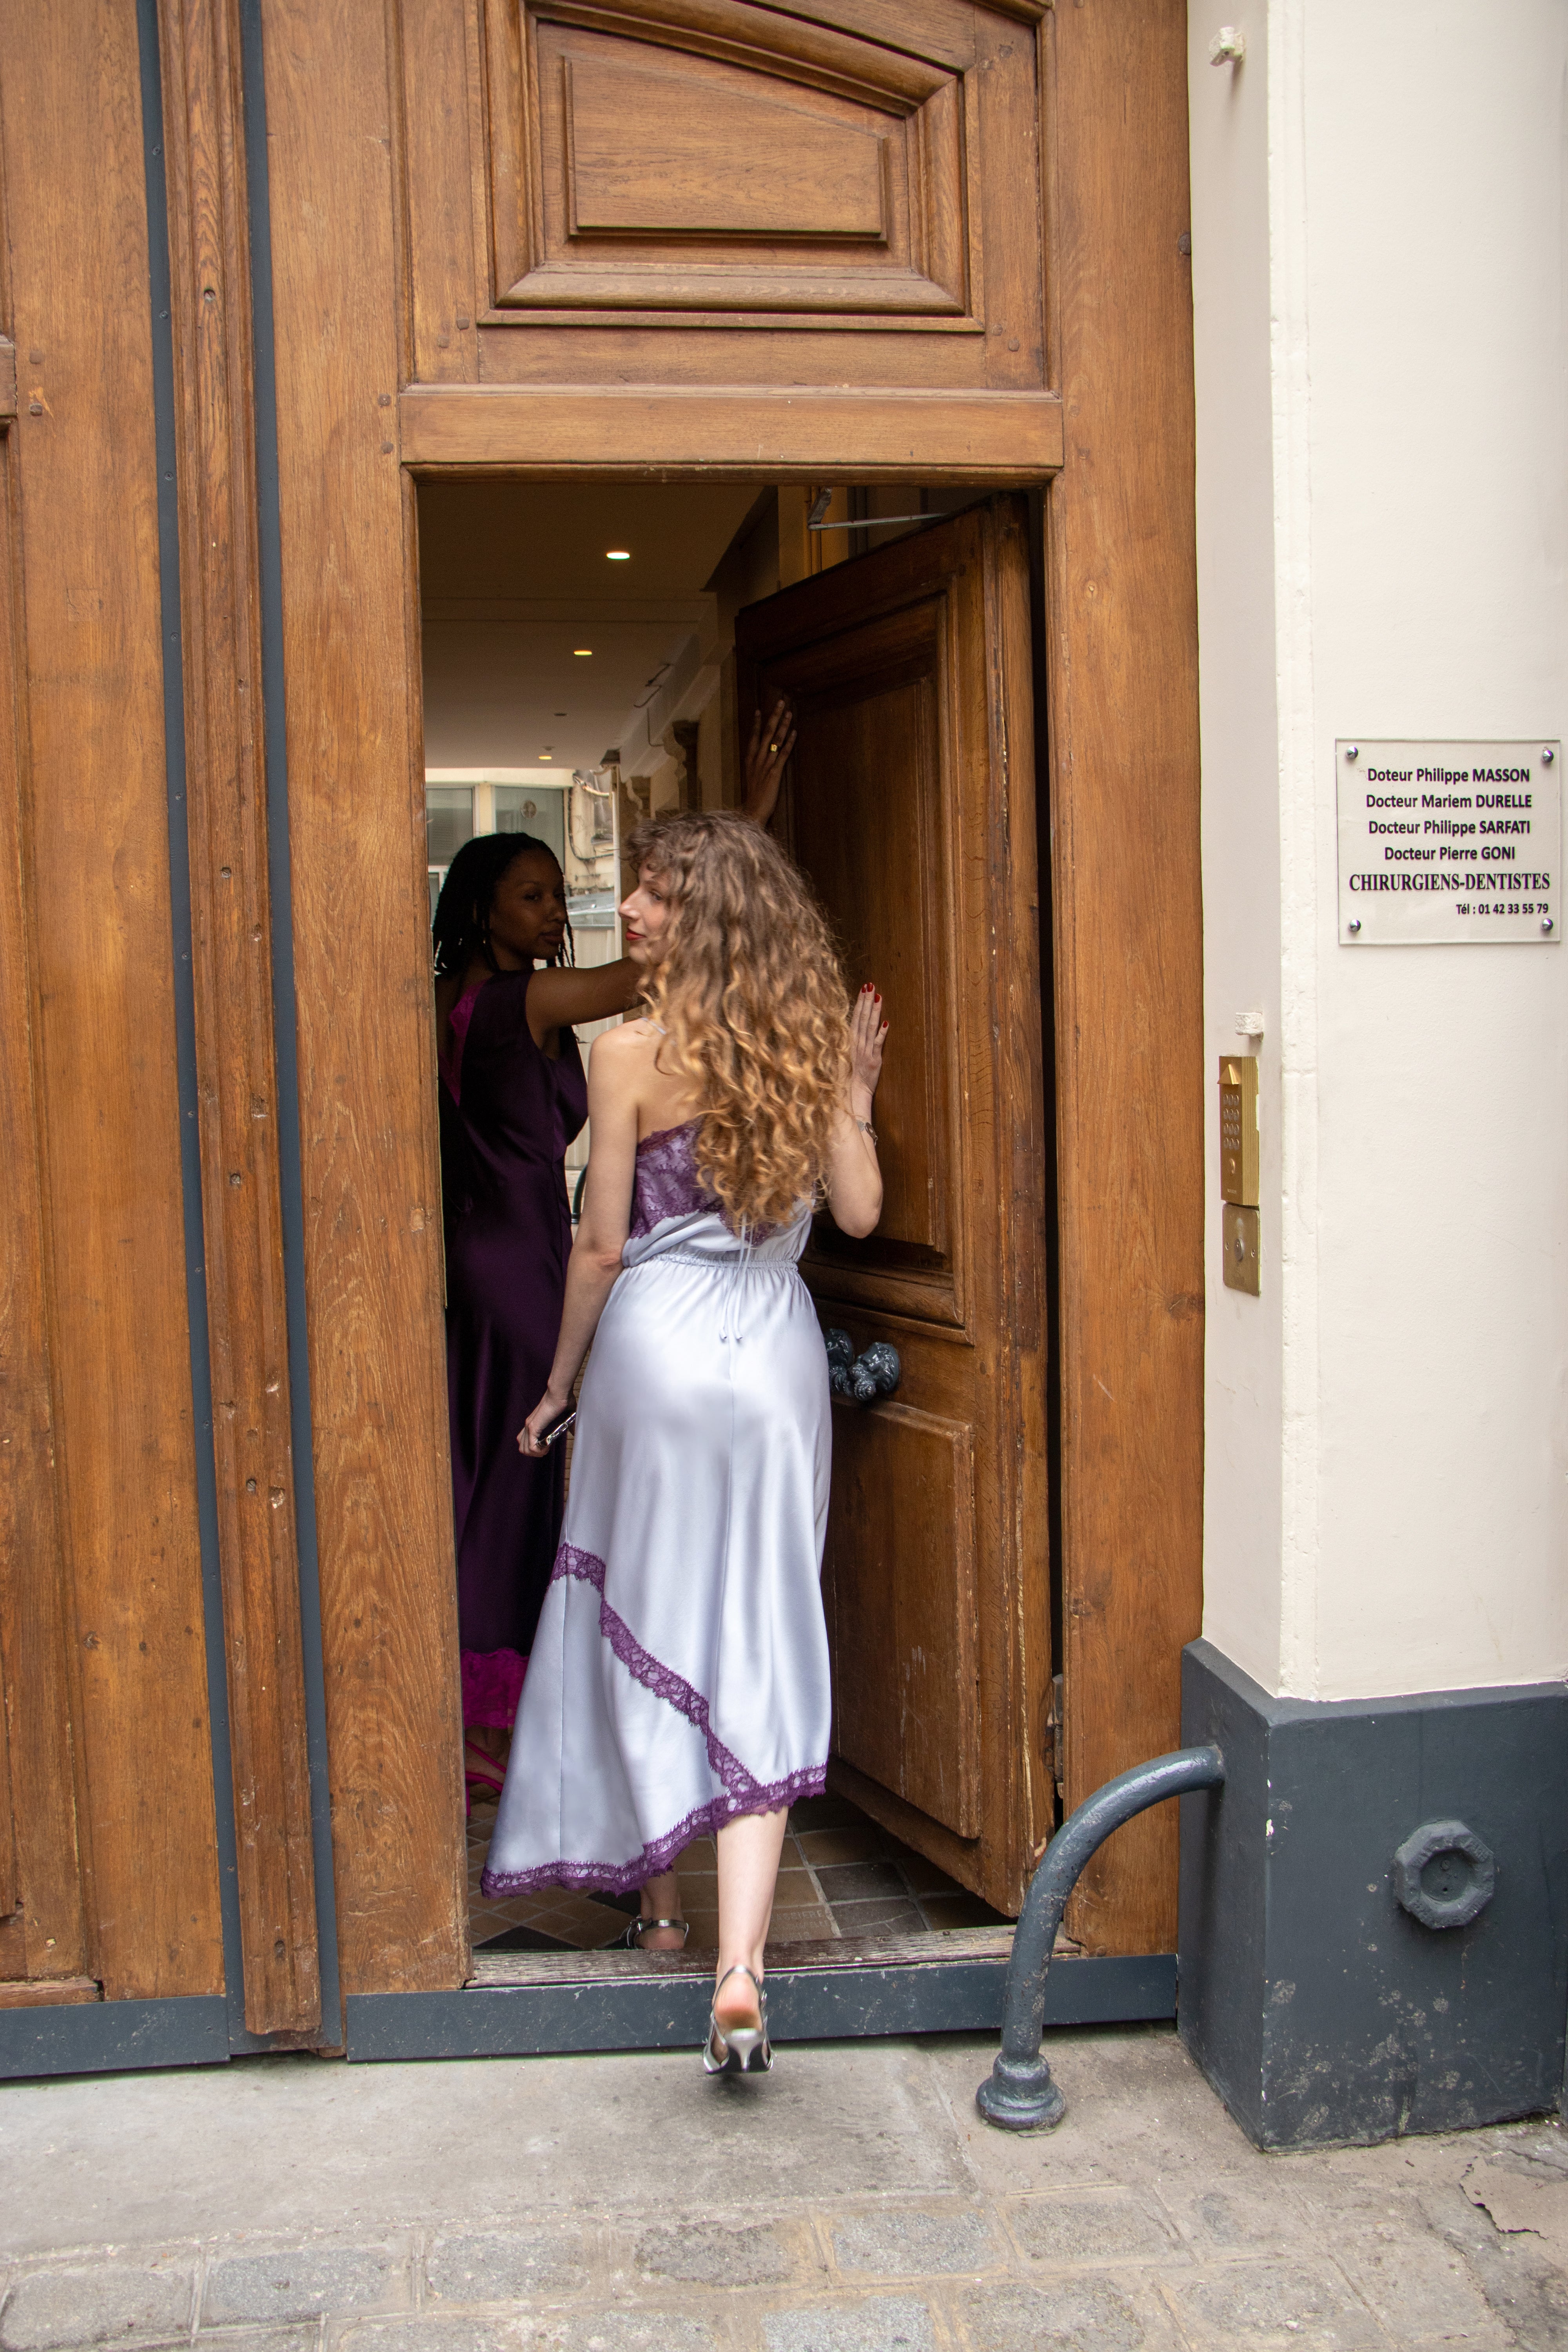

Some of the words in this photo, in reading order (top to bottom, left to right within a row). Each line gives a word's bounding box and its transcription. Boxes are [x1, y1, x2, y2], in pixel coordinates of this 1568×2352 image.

[1368, 768, 1413, 782] Doteur
[1416, 768, 1468, 785] Philippe
[1472, 768, 1530, 783] MASSON
[1366, 794, 1418, 808] Docteur
[1421, 794, 1472, 808] Mariem
[1475, 795, 1532, 809] DURELLE
[1368, 820, 1420, 834] Docteur
[1424, 820, 1476, 837] Philippe
[1479, 820, 1530, 835] SARFATI
[1385, 847, 1436, 860] Docteur
[1439, 846, 1477, 860] Pierre
[1481, 846, 1515, 860] GONI
[1349, 873, 1550, 892] CHIRURGIENS-DENTISTES
[1455, 903, 1470, 915] Tél
[1478, 904, 1490, 915] 01
[1492, 904, 1505, 915] 42
[1507, 903, 1519, 915] 33
[1522, 903, 1534, 915] 55
[1536, 903, 1548, 914] 79
